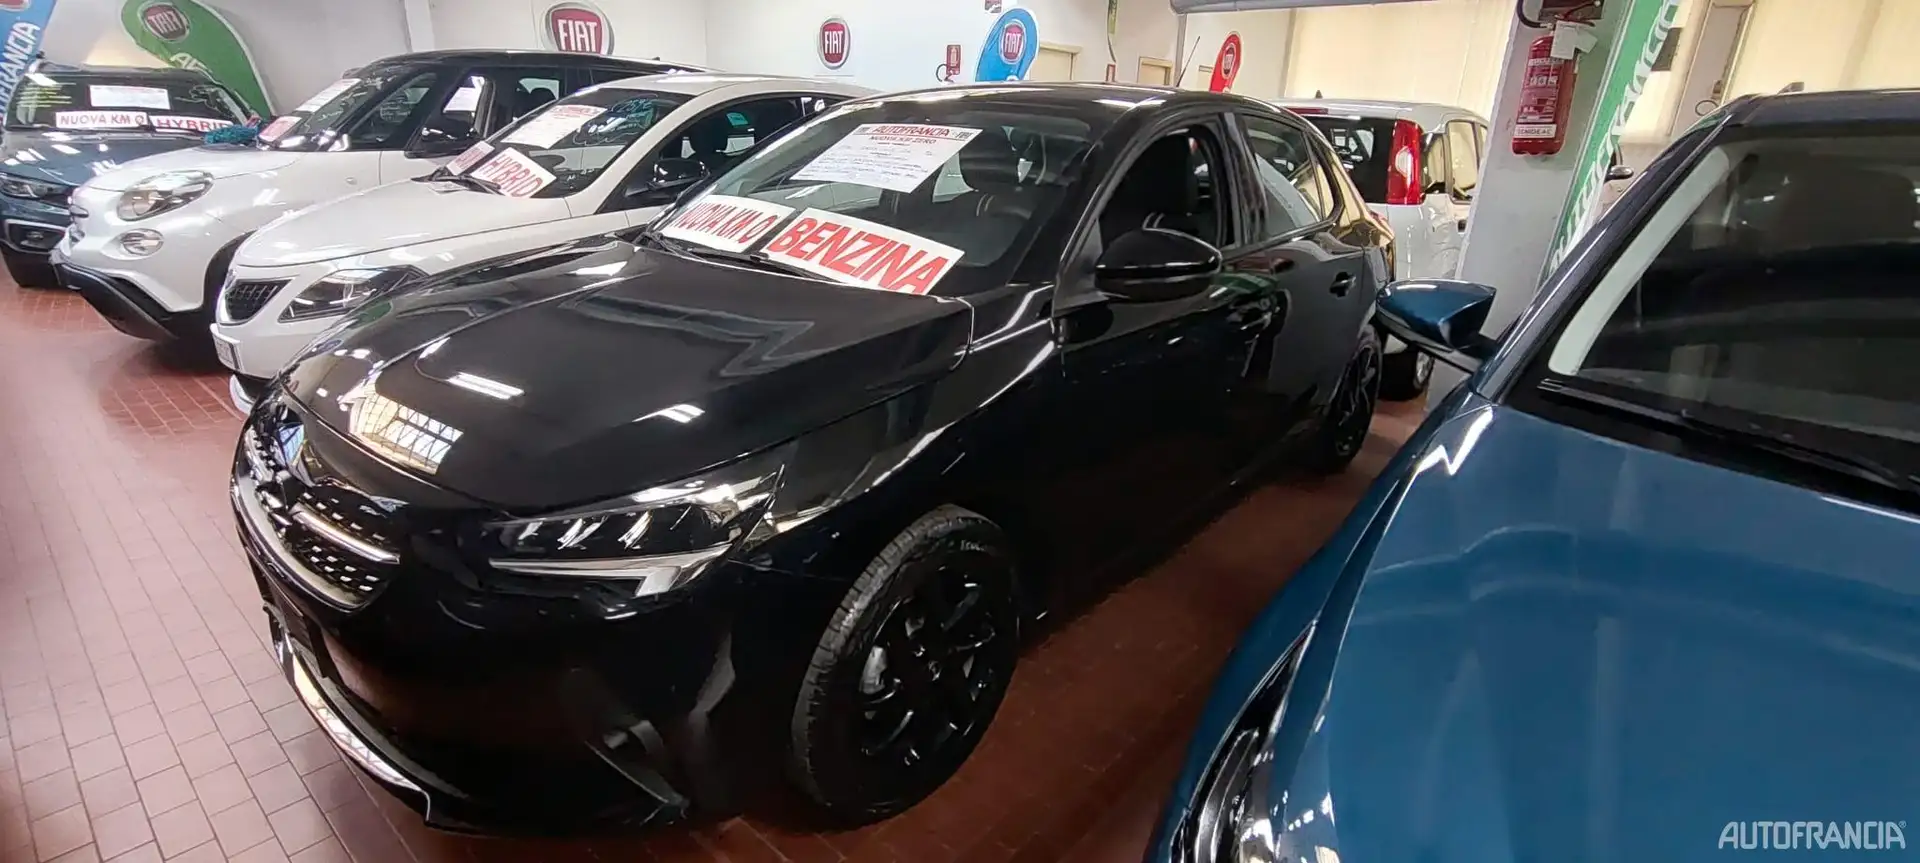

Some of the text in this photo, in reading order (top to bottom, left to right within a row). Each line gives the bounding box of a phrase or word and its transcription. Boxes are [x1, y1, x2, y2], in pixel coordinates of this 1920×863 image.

[557, 18, 598, 53] FIAT
[824, 30, 843, 54] FIAT
[1004, 32, 1022, 54] FIAT
[60, 114, 107, 125] NUOVA
[110, 115, 131, 125] KM
[871, 125, 951, 136] AUTOFRANCIA
[478, 153, 544, 197] HYBRID
[668, 202, 738, 234] NUOVA
[710, 208, 764, 240] KM
[767, 217, 949, 295] BENZINA
